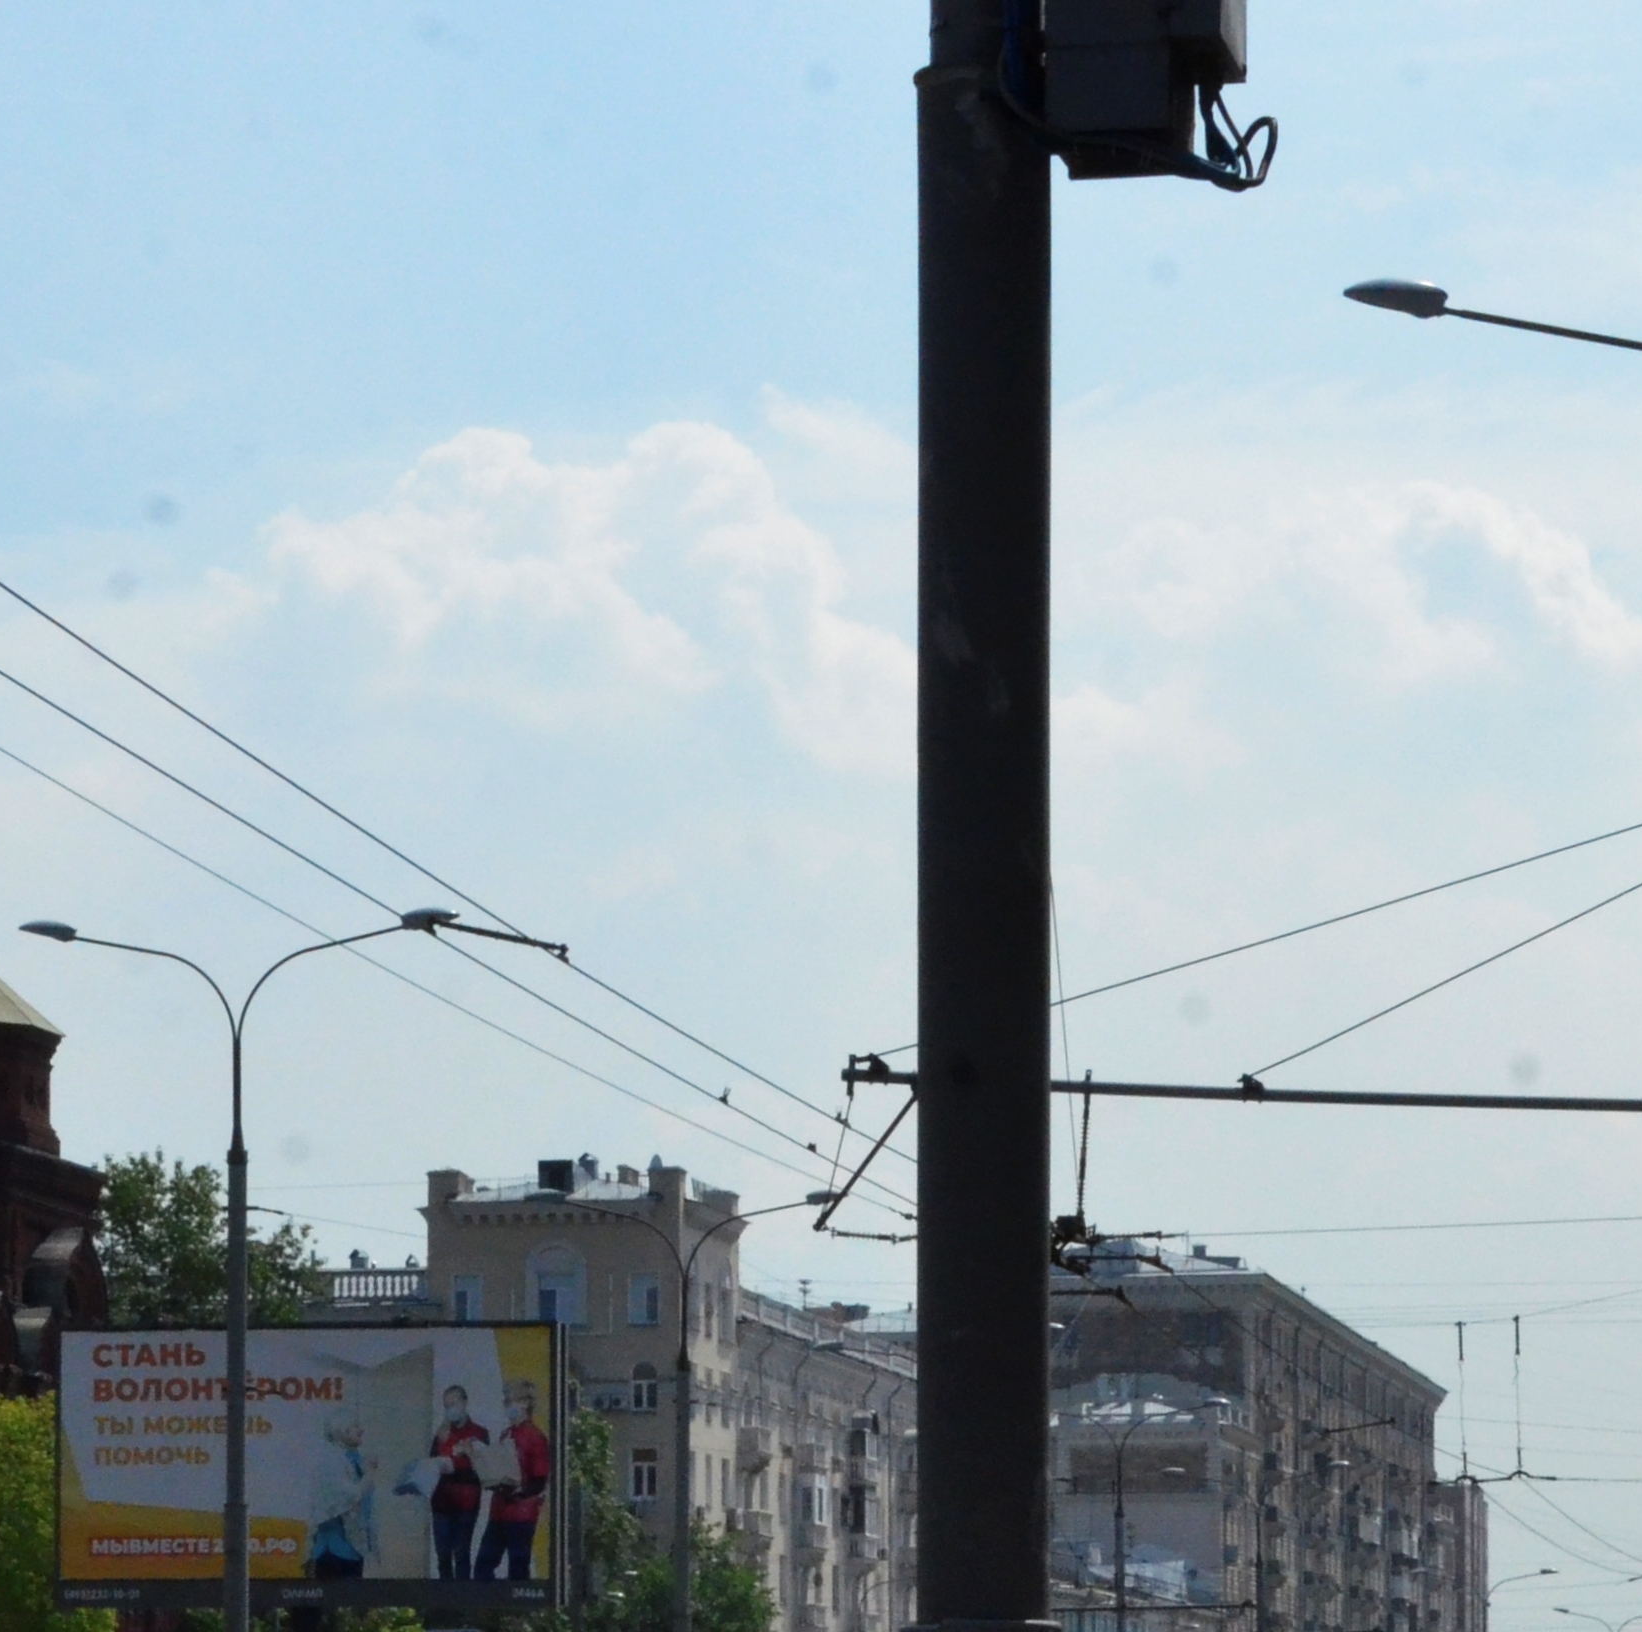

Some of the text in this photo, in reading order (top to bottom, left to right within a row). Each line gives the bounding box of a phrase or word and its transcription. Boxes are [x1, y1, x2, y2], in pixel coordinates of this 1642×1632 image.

[92, 1342, 206, 1368] СТАНЬ
[94, 1415, 273, 1435] ТЫ МОЖЕЬ
[94, 1446, 211, 1466] ПОМОЧЬ
